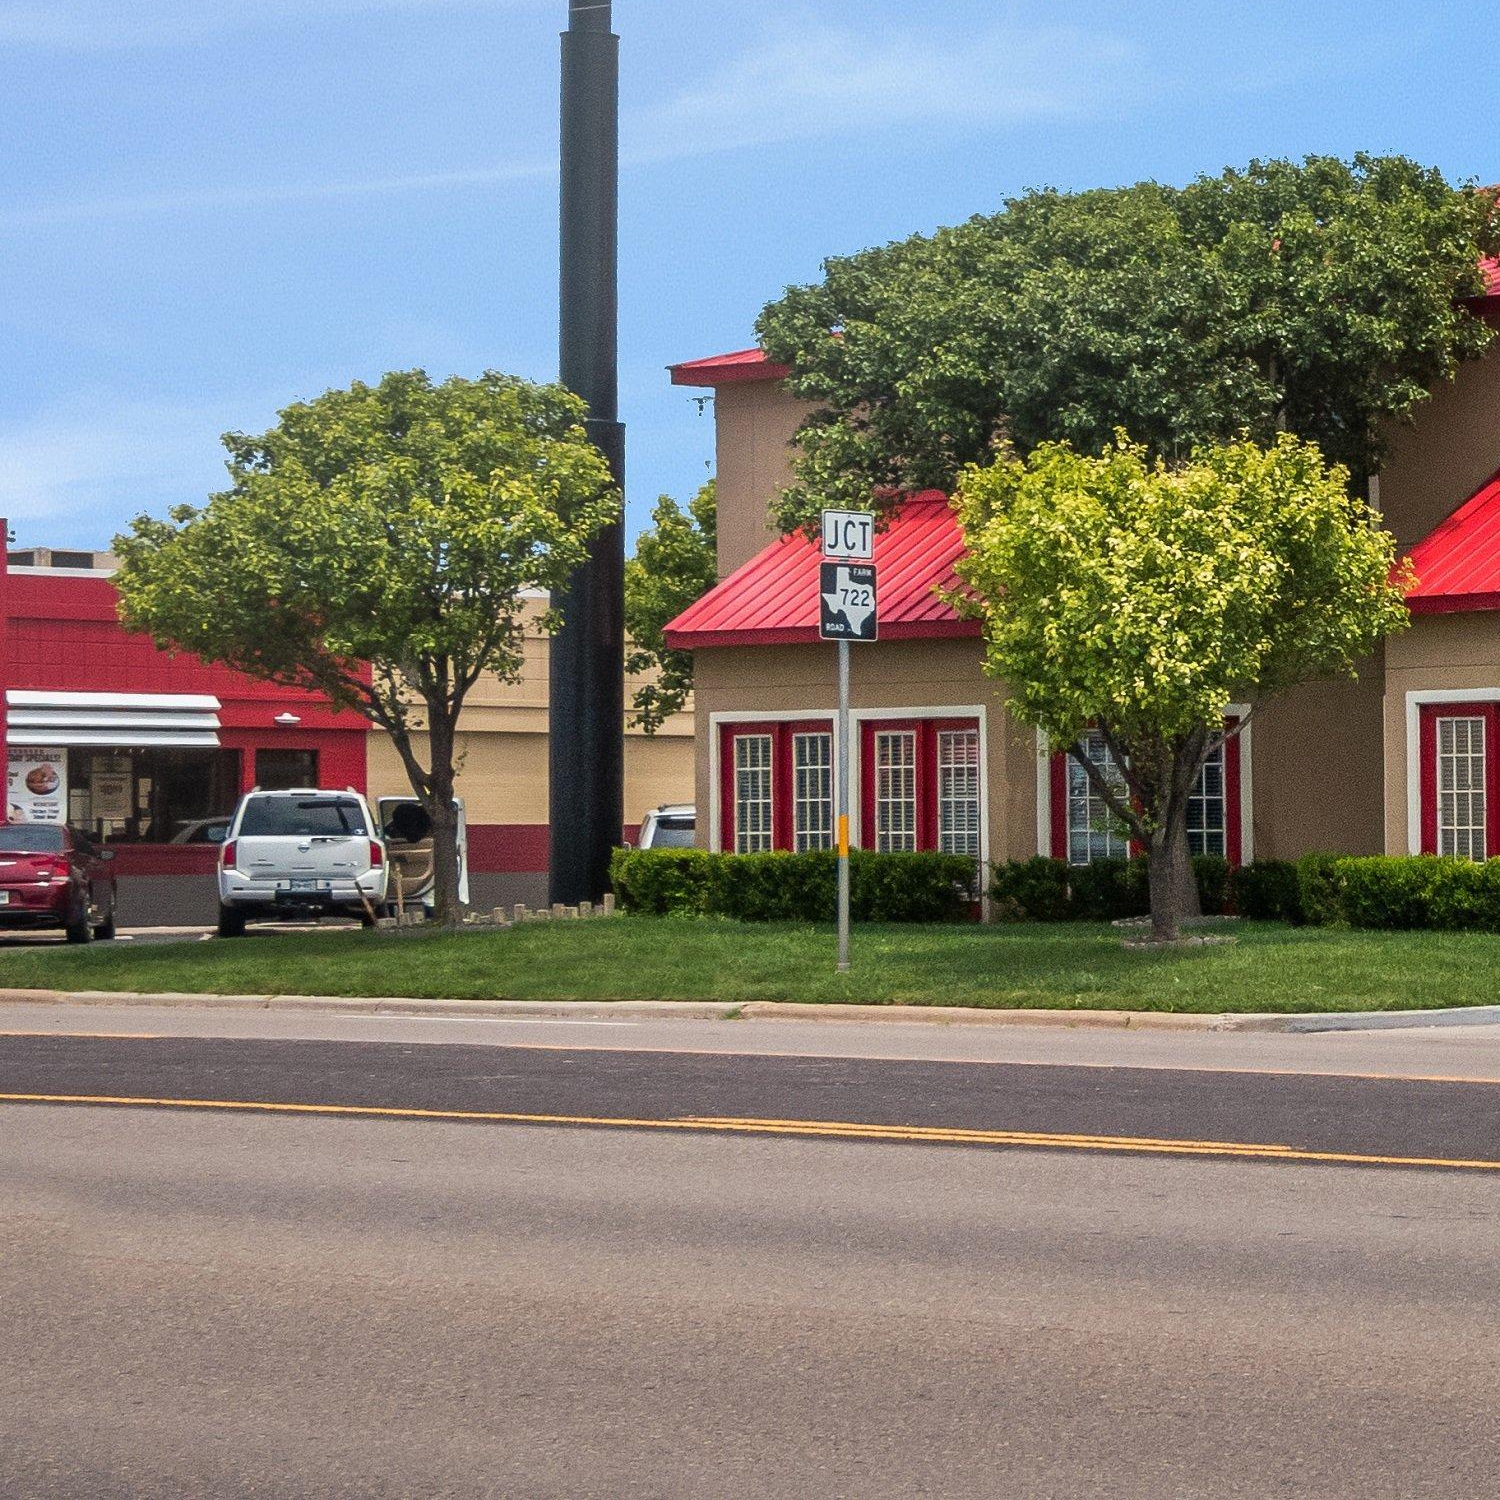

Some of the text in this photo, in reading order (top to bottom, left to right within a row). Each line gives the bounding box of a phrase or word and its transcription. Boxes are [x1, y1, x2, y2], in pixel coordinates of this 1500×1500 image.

[827, 519, 870, 551] JCT
[853, 567, 872, 576] FARM
[840, 588, 870, 607] 722
[826, 622, 845, 632] ROAD
